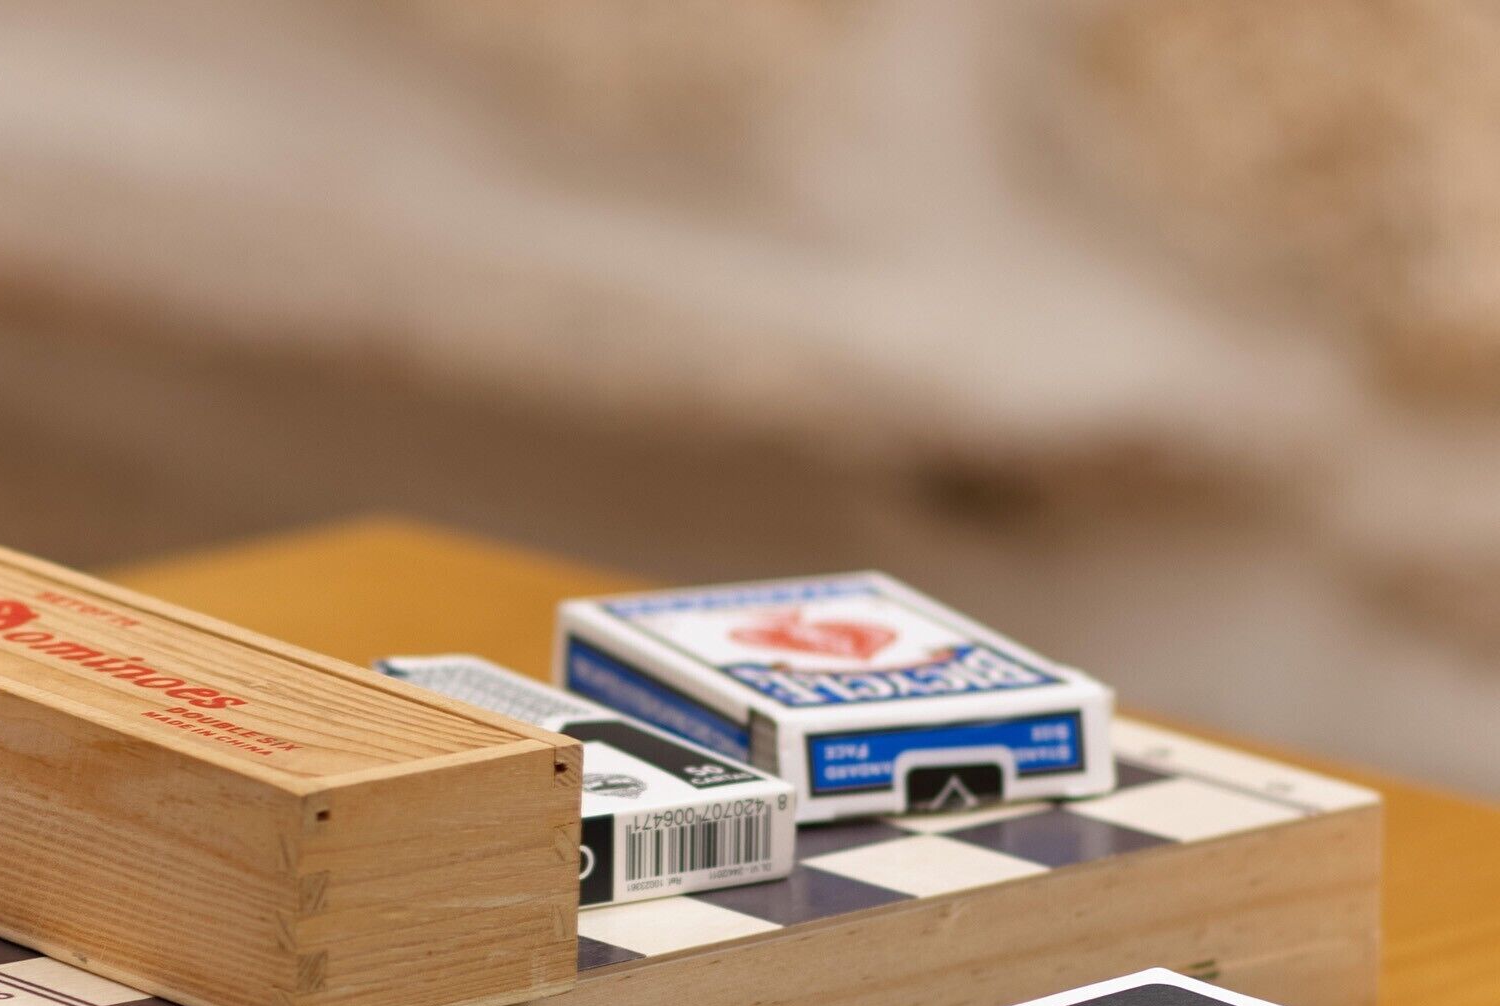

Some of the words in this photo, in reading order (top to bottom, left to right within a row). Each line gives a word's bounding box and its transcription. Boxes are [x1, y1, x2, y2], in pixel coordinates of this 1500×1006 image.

[727, 648, 1038, 707] BICYCLE
[141, 711, 195, 729] MADE
[191, 728, 216, 737] IN
[215, 736, 273, 755] CHINA
[164, 707, 261, 739] DOUBLE
[256, 736, 303, 750] SIX
[700, 799, 765, 822] 420707
[777, 793, 788, 810] 8
[633, 807, 695, 831] 006471
